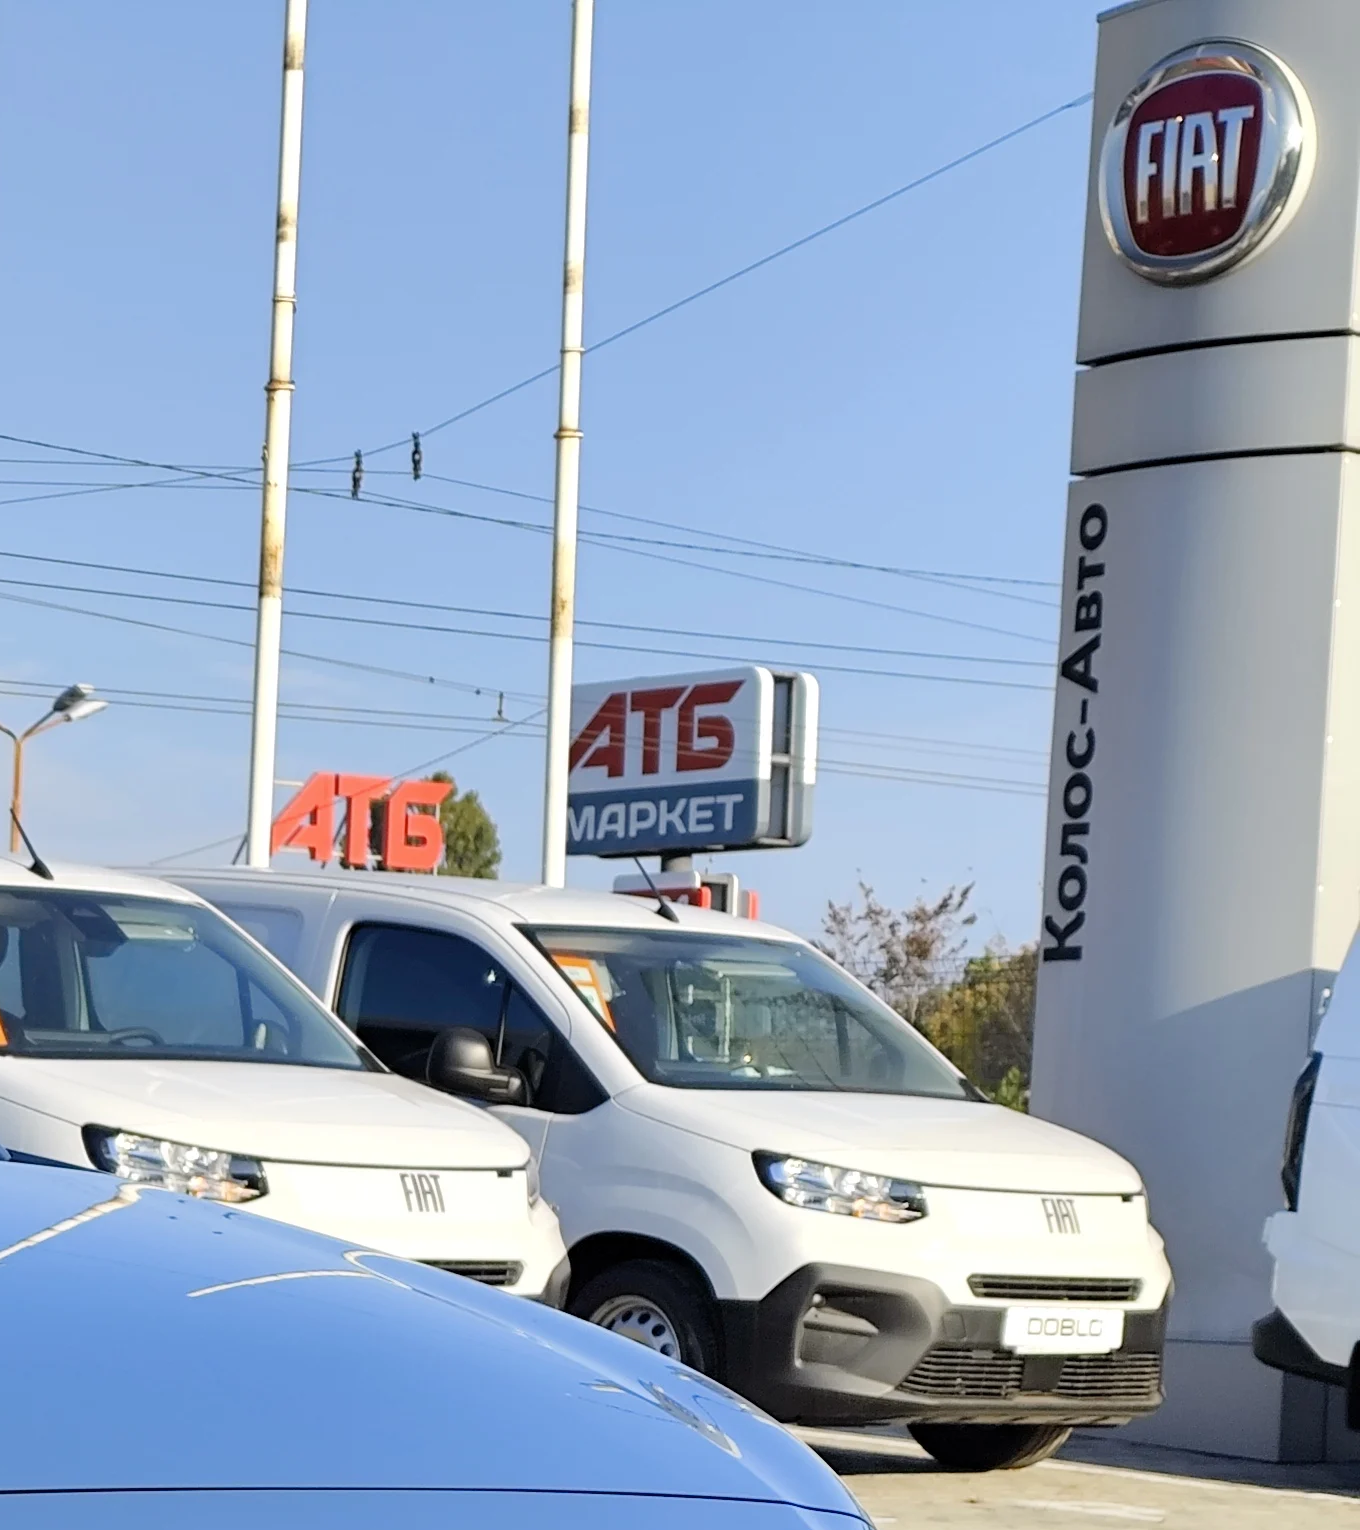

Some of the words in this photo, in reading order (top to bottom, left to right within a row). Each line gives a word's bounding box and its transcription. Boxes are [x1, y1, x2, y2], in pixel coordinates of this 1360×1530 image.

[1137, 105, 1255, 224] FIAT
[570, 680, 747, 778] АТБ
[1043, 502, 1108, 962] Колос-Авто
[270, 771, 454, 869] АТБ
[568, 793, 744, 842] МАРКЕТ
[399, 1173, 445, 1213] FIAT
[1041, 1198, 1081, 1234] FIAT
[1027, 1317, 1103, 1337] DOBLO
